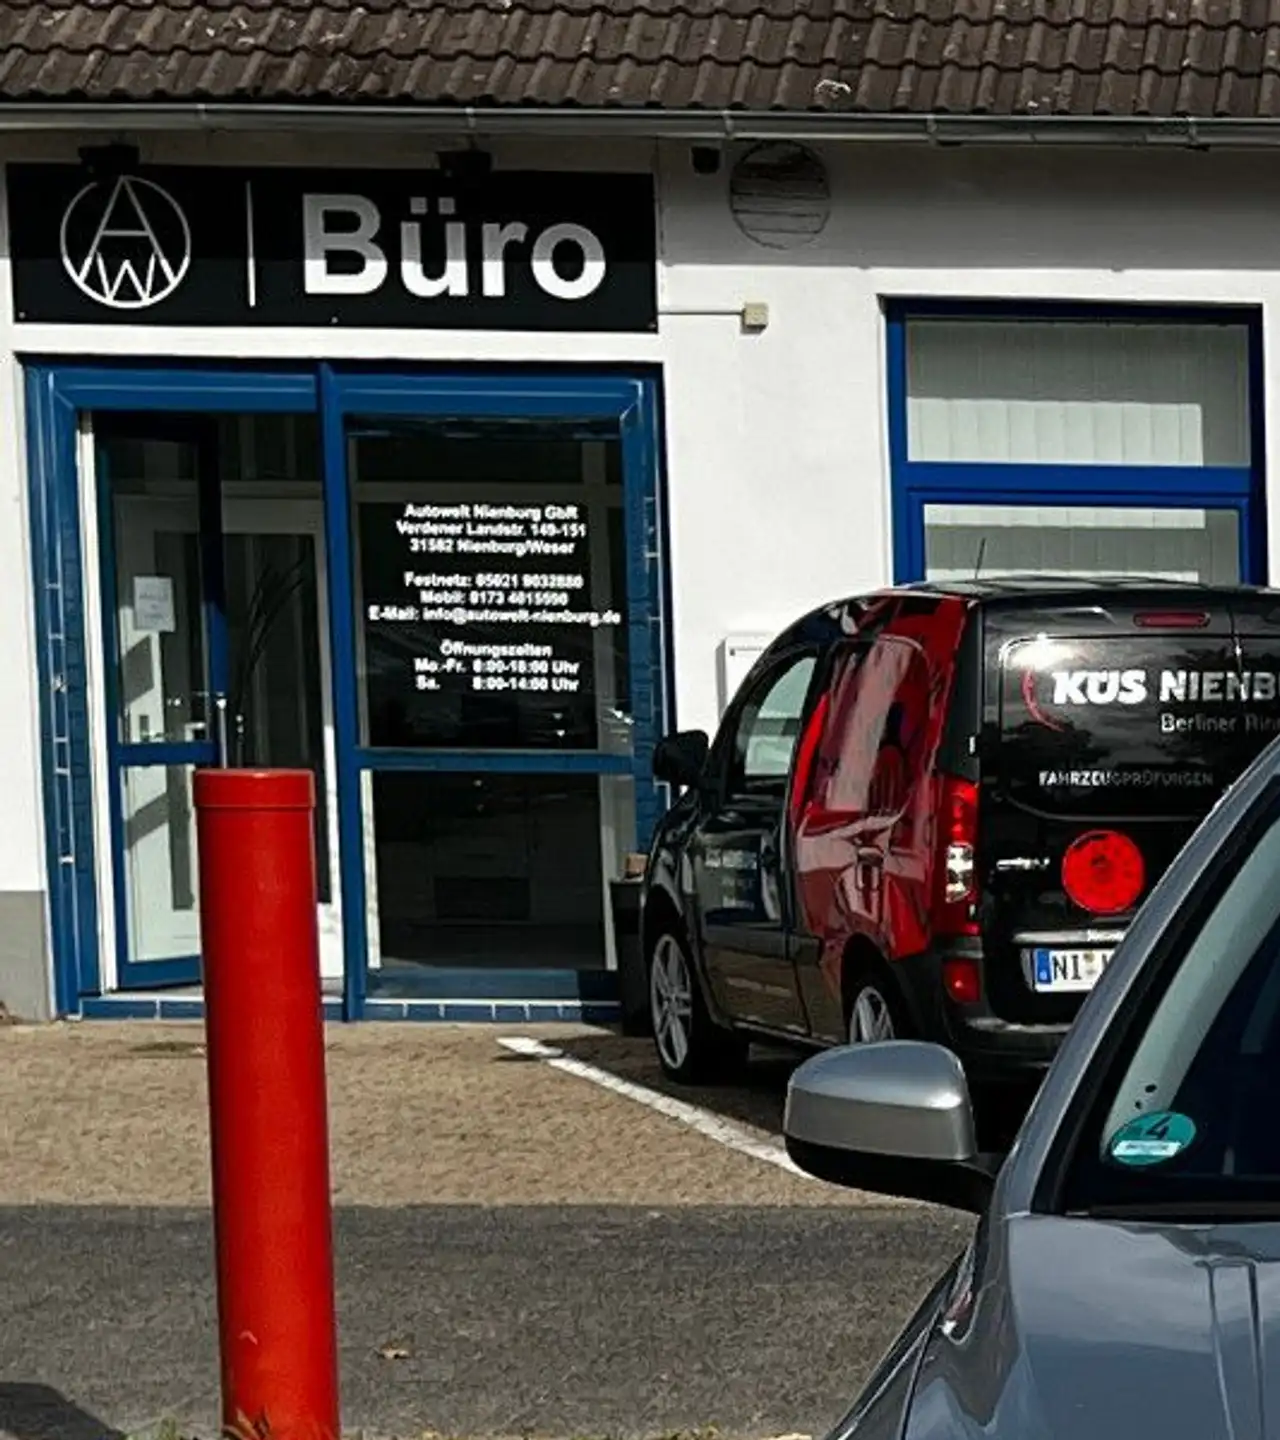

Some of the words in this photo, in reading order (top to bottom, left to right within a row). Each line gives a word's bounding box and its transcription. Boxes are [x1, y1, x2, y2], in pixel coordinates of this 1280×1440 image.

[301, 193, 607, 300] Büro
[552, 661, 579, 674] Uhr
[552, 677, 579, 691] Uhr
[1052, 670, 1147, 705] KÜS
[1161, 713, 1236, 733] Berliner
[1038, 769, 1214, 786] FAHRZEUGPRÜFUNGEN
[1147, 1115, 1172, 1140] 4
